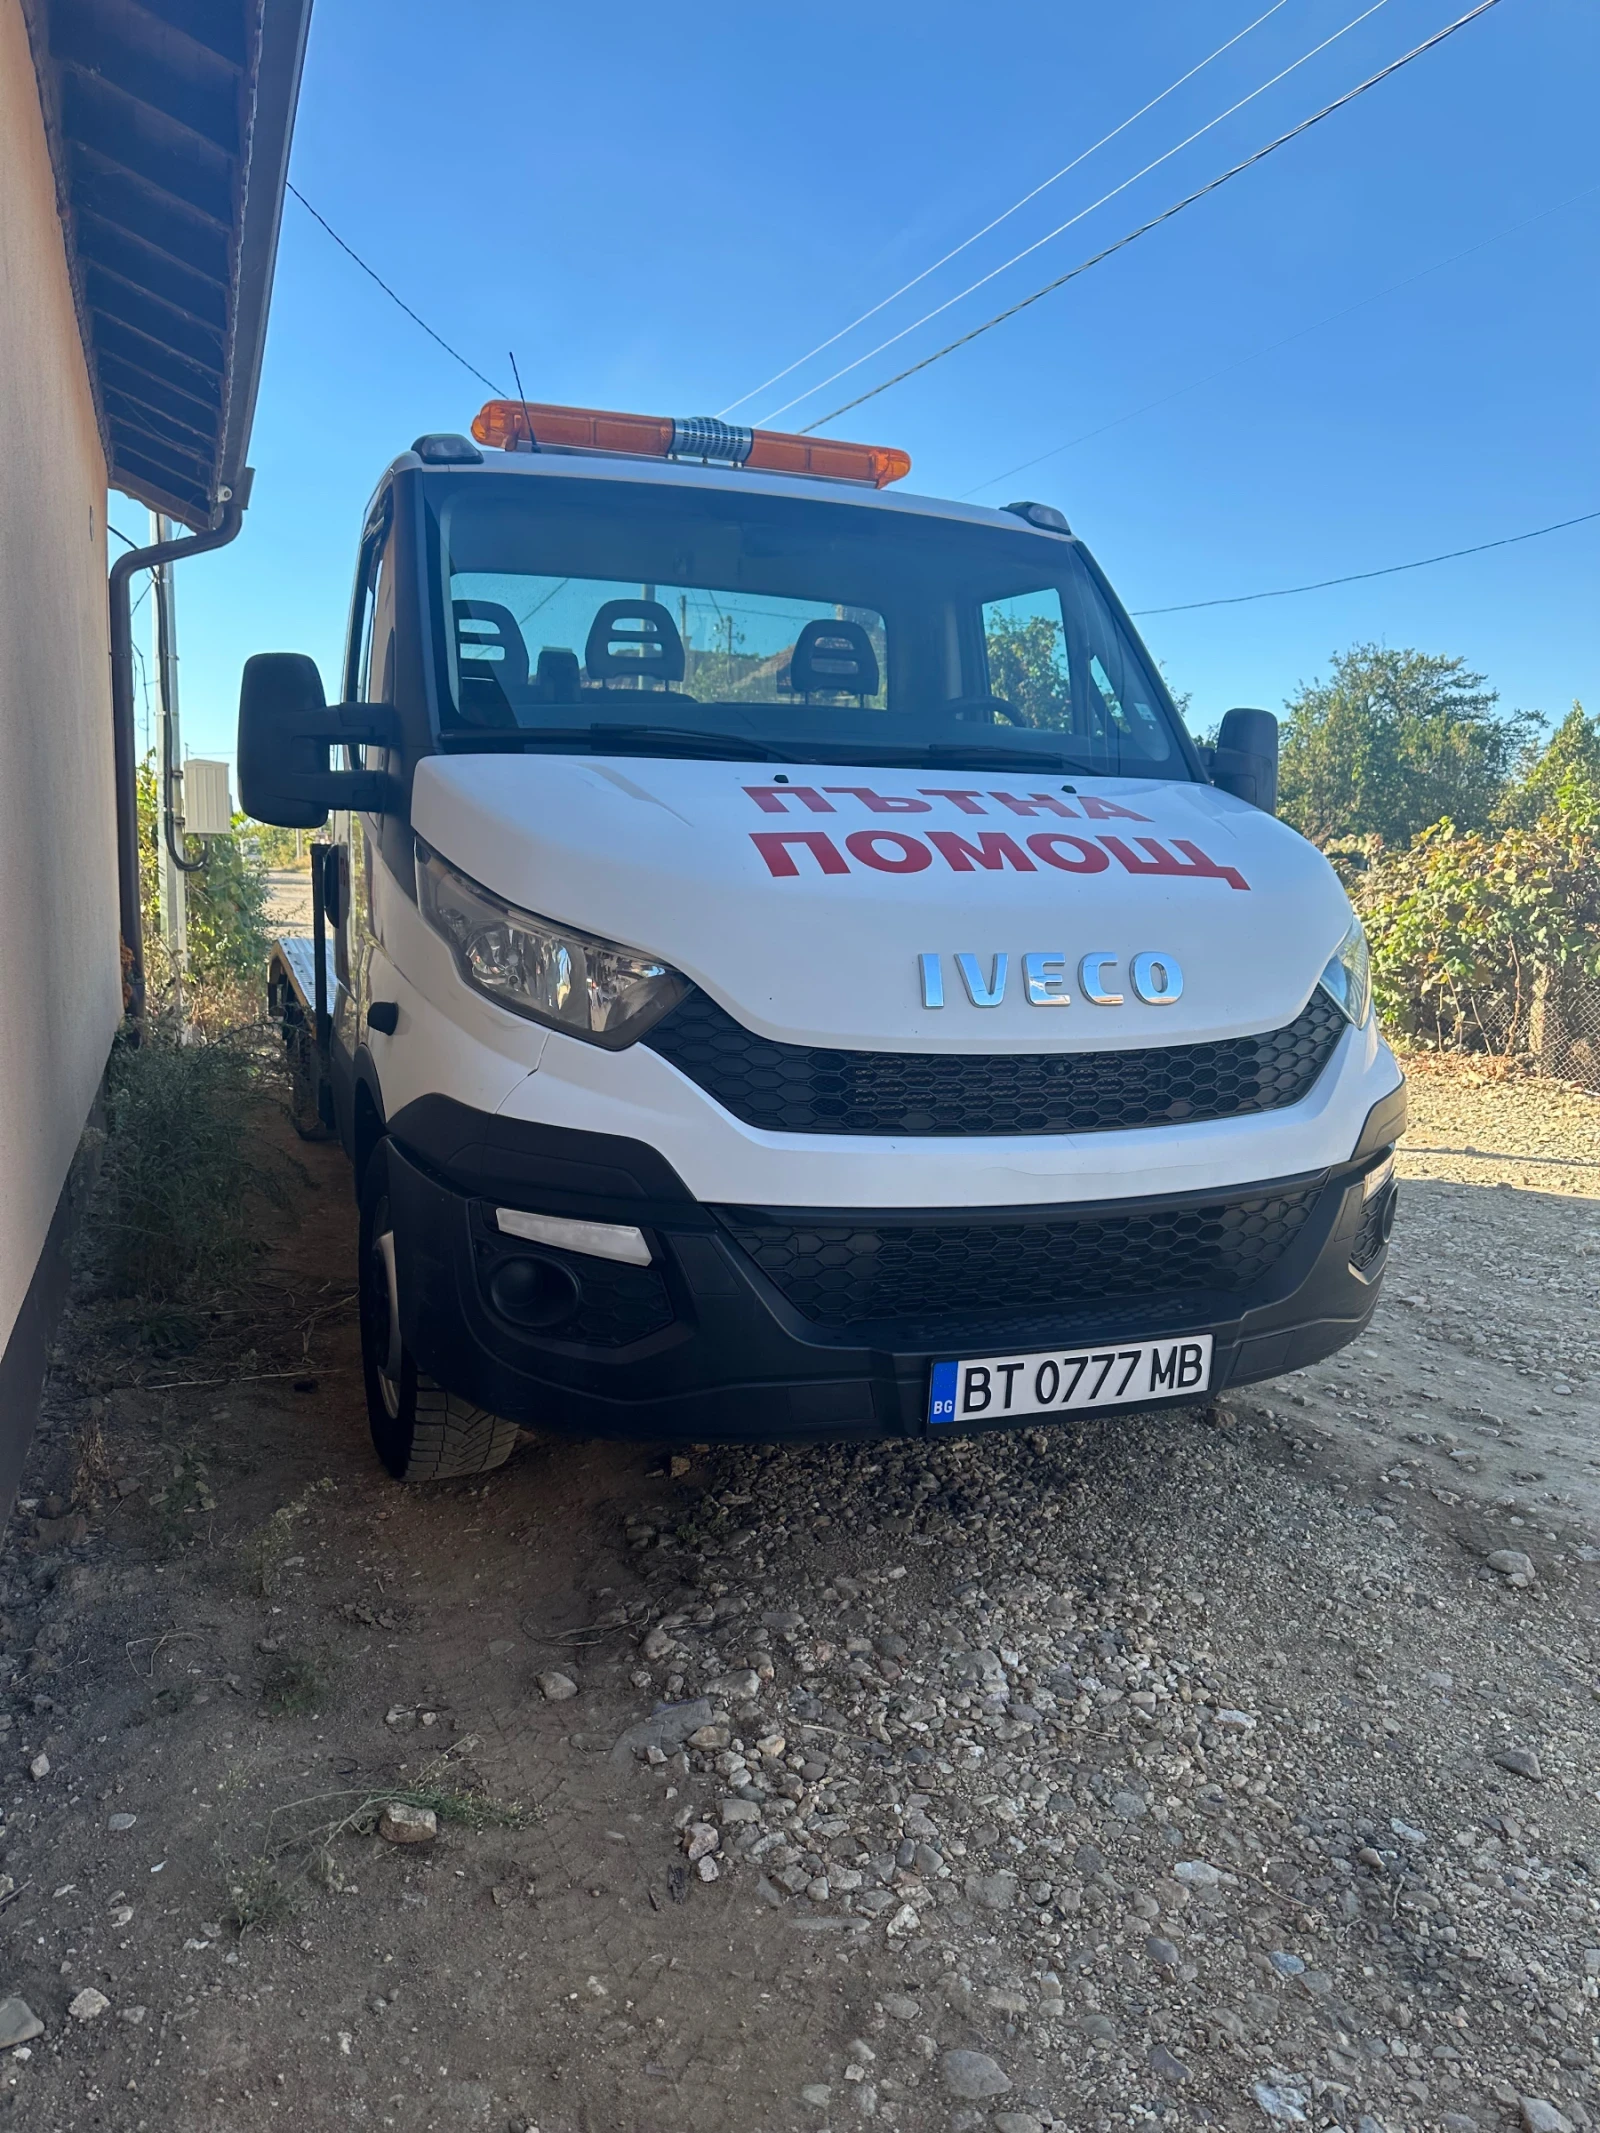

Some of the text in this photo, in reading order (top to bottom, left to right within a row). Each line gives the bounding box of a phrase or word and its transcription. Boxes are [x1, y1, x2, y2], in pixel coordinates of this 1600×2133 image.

[741, 786, 1155, 822] ПЪТНА
[749, 830, 1251, 891] ПОМОЩ
[918, 951, 1184, 1010] IVECO
[933, 1400, 953, 1415] BG
[962, 1343, 1203, 1414] BT 0777 MB
